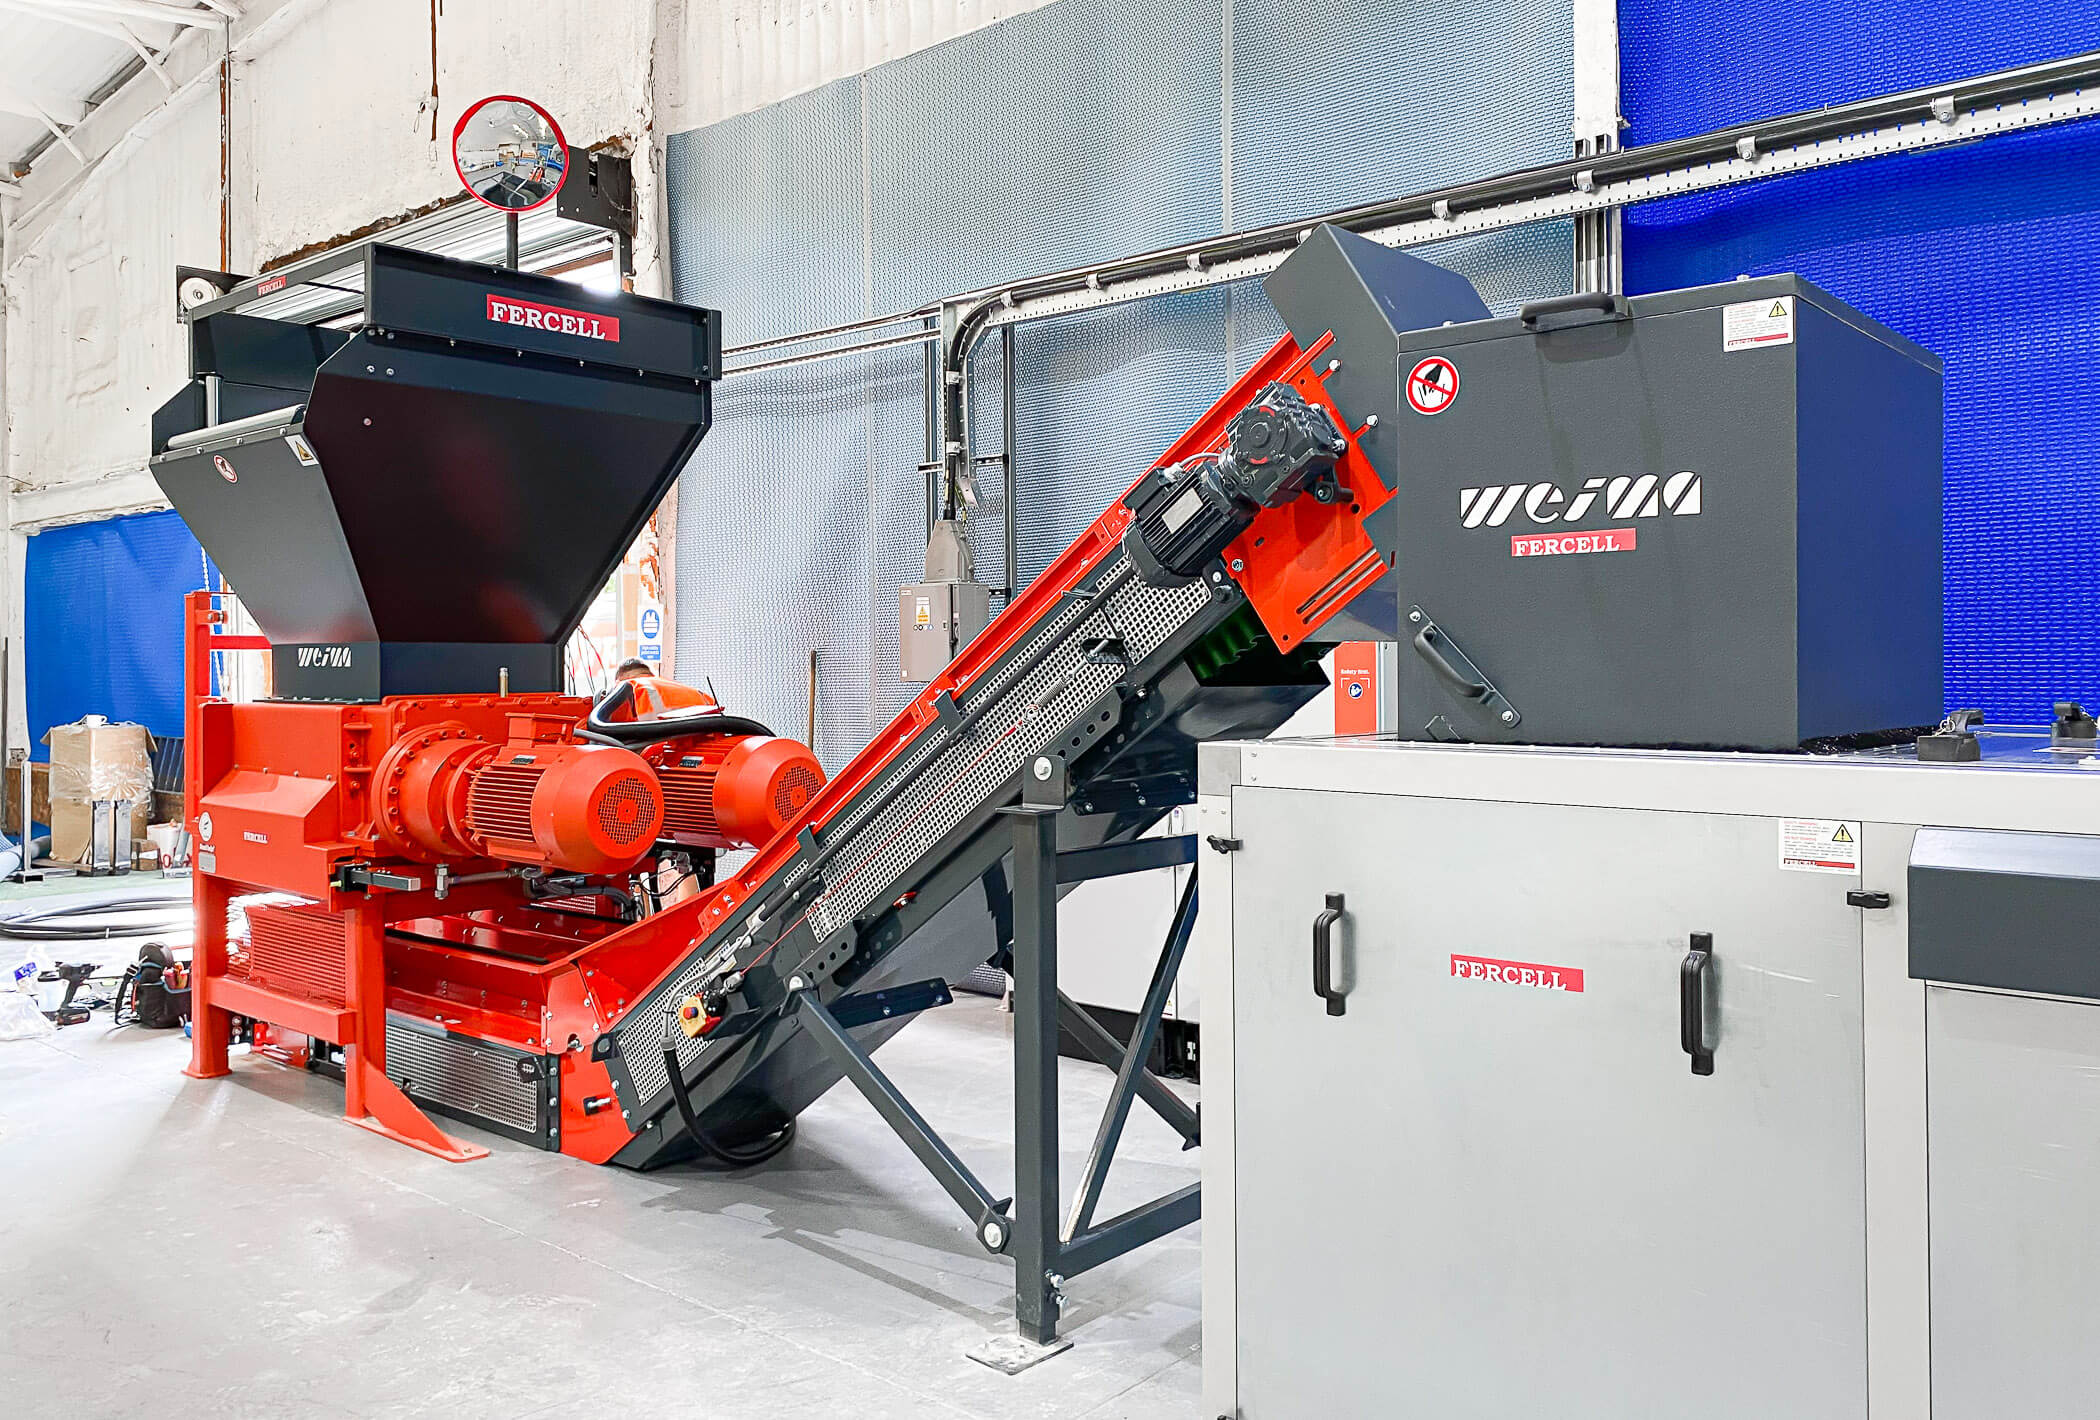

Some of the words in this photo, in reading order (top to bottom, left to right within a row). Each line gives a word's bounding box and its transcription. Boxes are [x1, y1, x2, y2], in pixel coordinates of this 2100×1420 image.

[258, 279, 283, 296] FERCELL
[491, 302, 606, 340] FERCELL
[1514, 535, 1620, 557] FERCELL
[1453, 960, 1567, 991] FERCELL
